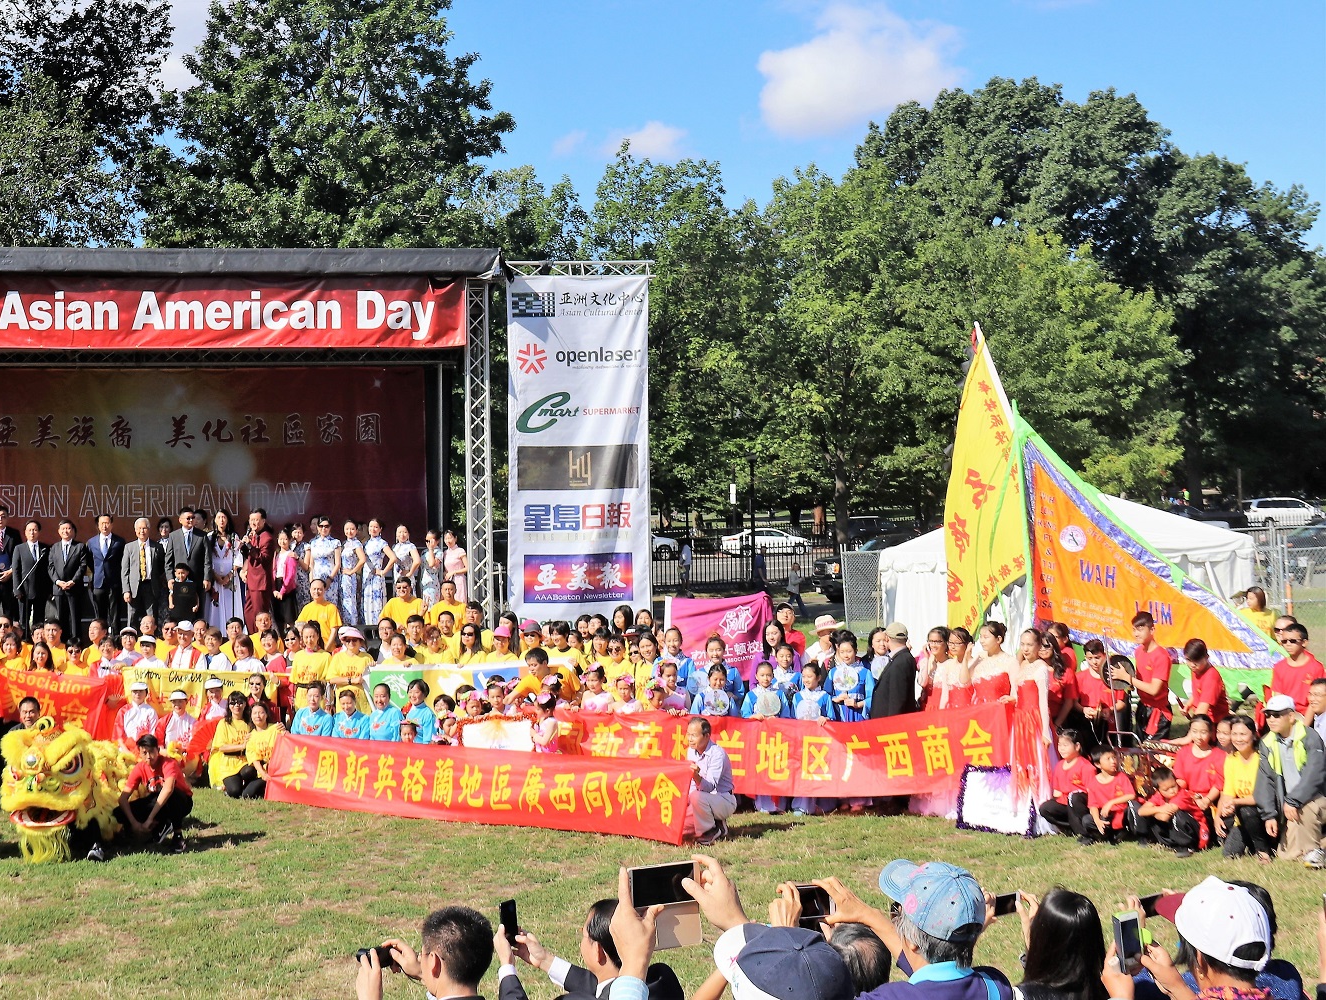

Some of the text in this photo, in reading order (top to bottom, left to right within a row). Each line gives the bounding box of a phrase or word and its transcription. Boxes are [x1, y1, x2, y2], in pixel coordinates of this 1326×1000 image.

[559, 291, 645, 306] 亚洲文化中心
[132, 290, 341, 331] American
[355, 290, 435, 340] Day
[558, 308, 644, 317] Asian Cultural Center
[555, 346, 641, 367] openlaser
[583, 406, 640, 415] SUPERMARKET
[79, 483, 239, 518] AMERICAN
[249, 481, 312, 516] DAY
[523, 502, 632, 531] 星島日報
[1079, 559, 1118, 589] WAH
[1037, 599, 1053, 608] USA
[282, 746, 682, 827] 美國新英格蘭地區廣西同鄉會
